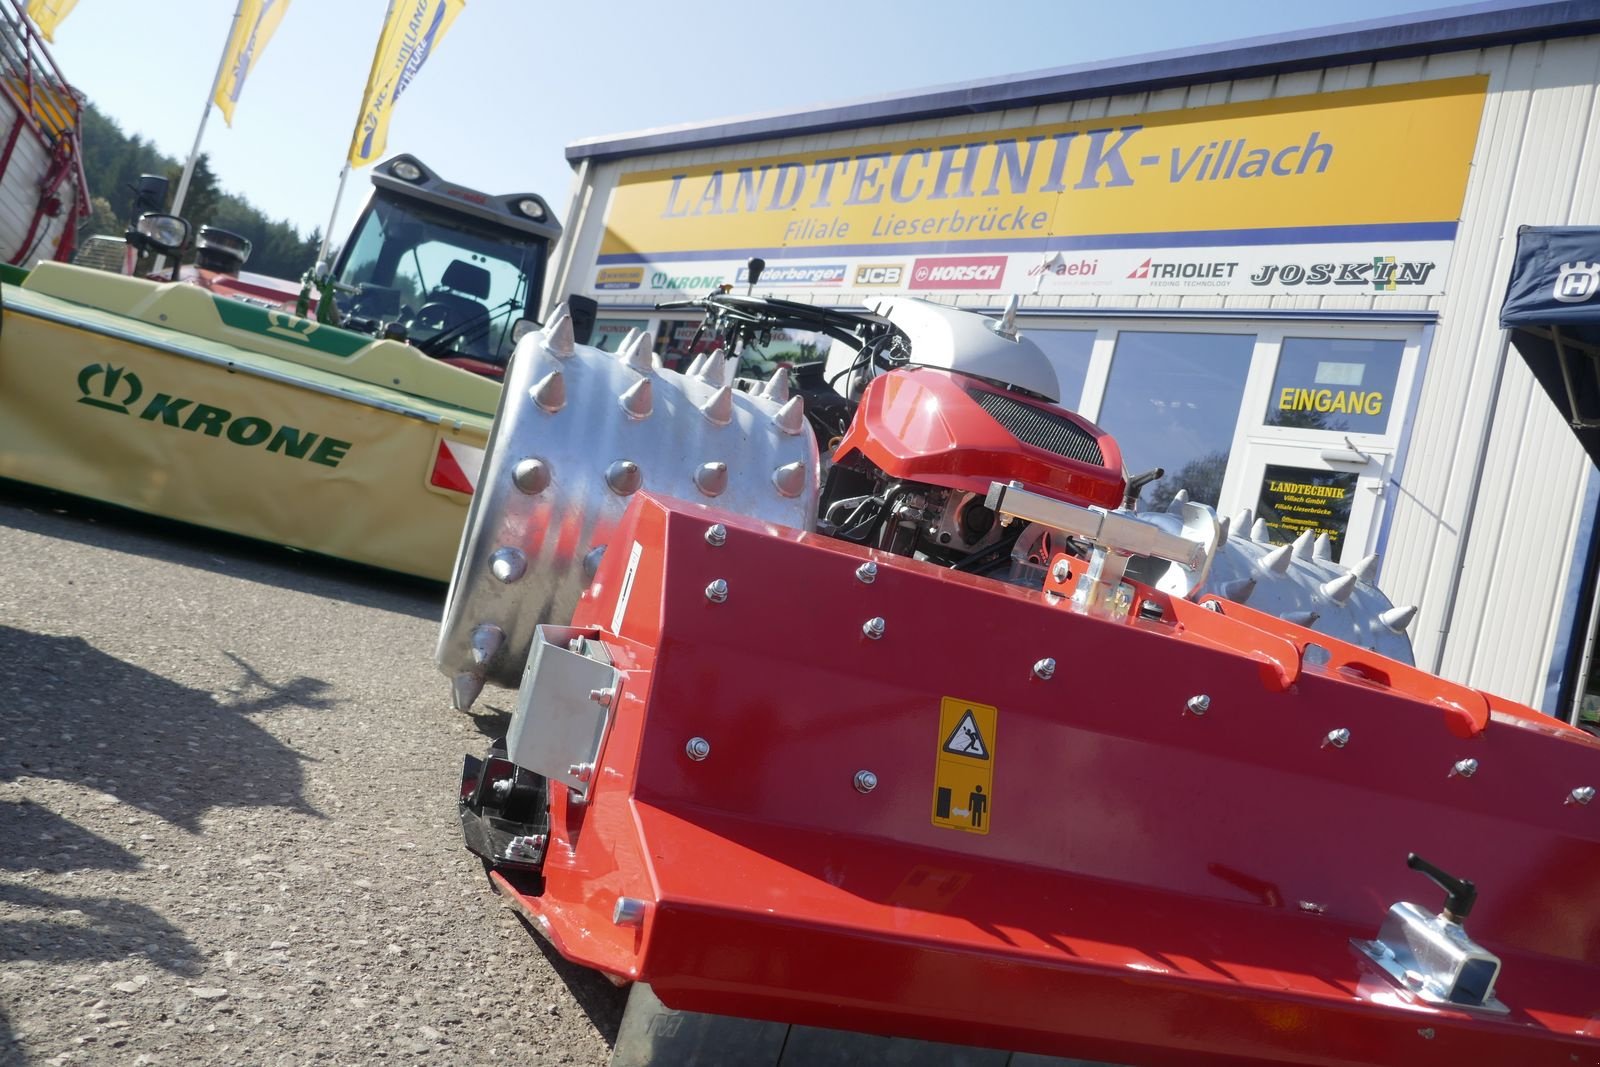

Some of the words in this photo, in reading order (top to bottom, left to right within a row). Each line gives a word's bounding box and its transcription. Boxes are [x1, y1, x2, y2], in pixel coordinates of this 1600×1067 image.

[783, 219, 850, 241] Filiale
[872, 205, 1048, 238] Lieserbrücke
[739, 267, 844, 281] Bderberger
[857, 267, 901, 284] JCB
[928, 265, 1001, 281] HORSCH
[1055, 259, 1098, 276] aebi
[1151, 262, 1239, 279] TRIOLIET
[1250, 260, 1436, 287] JOSKIN
[666, 275, 724, 289] KRONE
[1279, 387, 1383, 415] EINGANG
[139, 393, 353, 468] KRONE
[1269, 481, 1345, 498] LANDTECHNIK
[1283, 495, 1304, 503] Villach
[1305, 497, 1326, 505] GmbH
[1274, 503, 1292, 511] Filiale
[1292, 504, 1332, 515] Lieserbrücke
